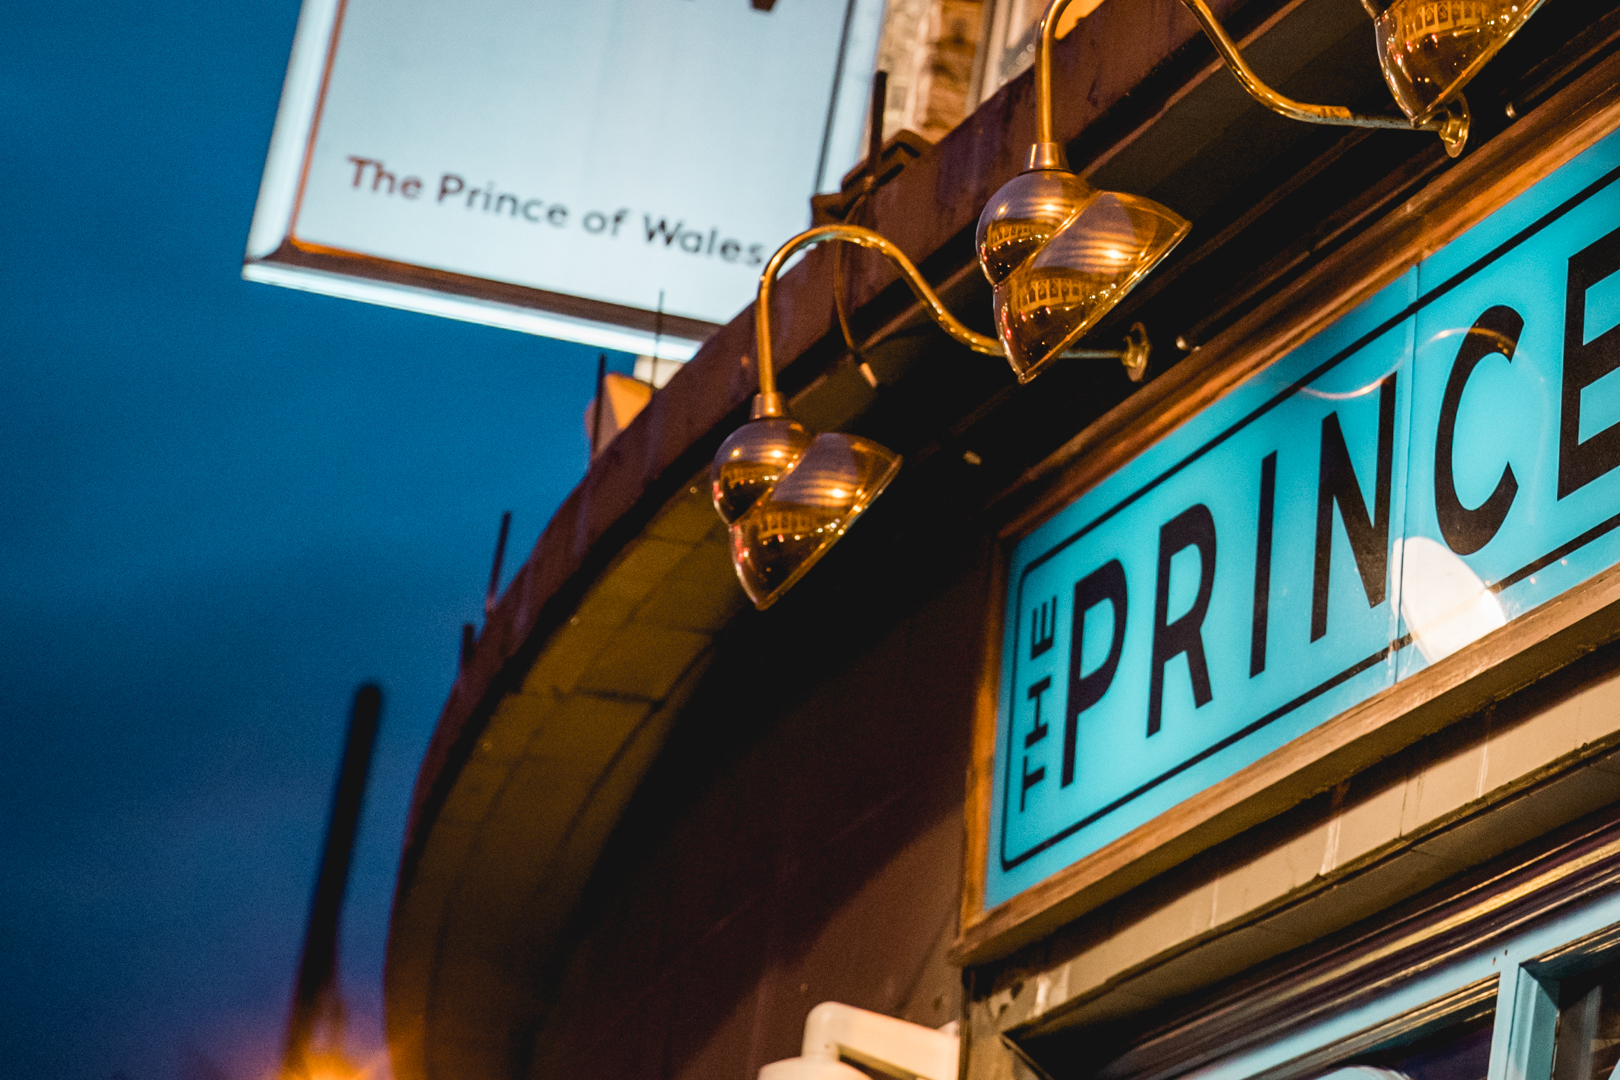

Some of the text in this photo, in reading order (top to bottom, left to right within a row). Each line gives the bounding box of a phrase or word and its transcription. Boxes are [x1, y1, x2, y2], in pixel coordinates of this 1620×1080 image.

[347, 154, 767, 267] The Prince of Wales
[1019, 594, 1058, 814] THE
